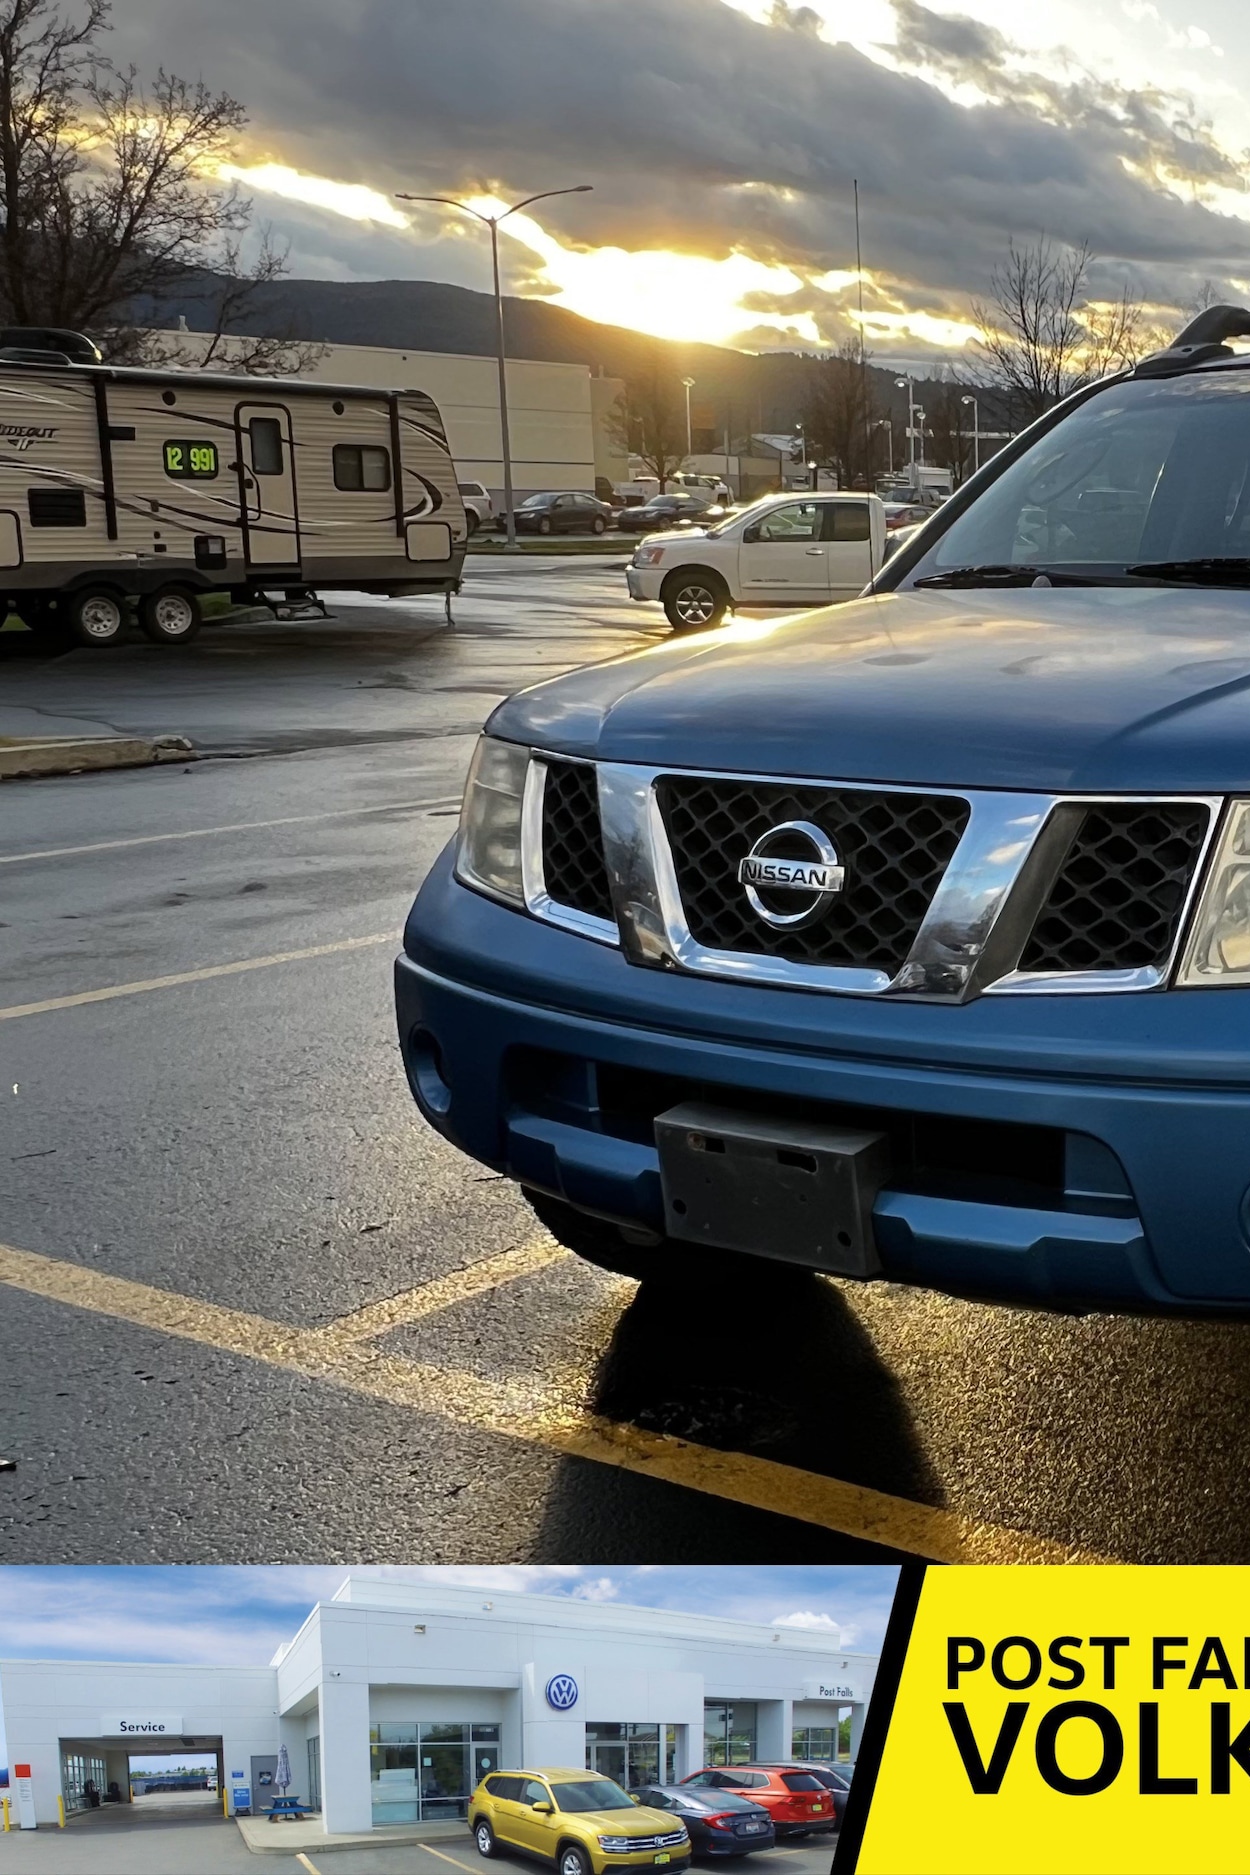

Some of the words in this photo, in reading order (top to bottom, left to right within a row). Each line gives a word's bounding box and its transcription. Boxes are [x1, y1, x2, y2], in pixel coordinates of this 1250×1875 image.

[0, 424, 60, 438] IDEOUT
[166, 446, 184, 470] 12
[190, 447, 215, 471] 991
[744, 862, 827, 887] NISSAN
